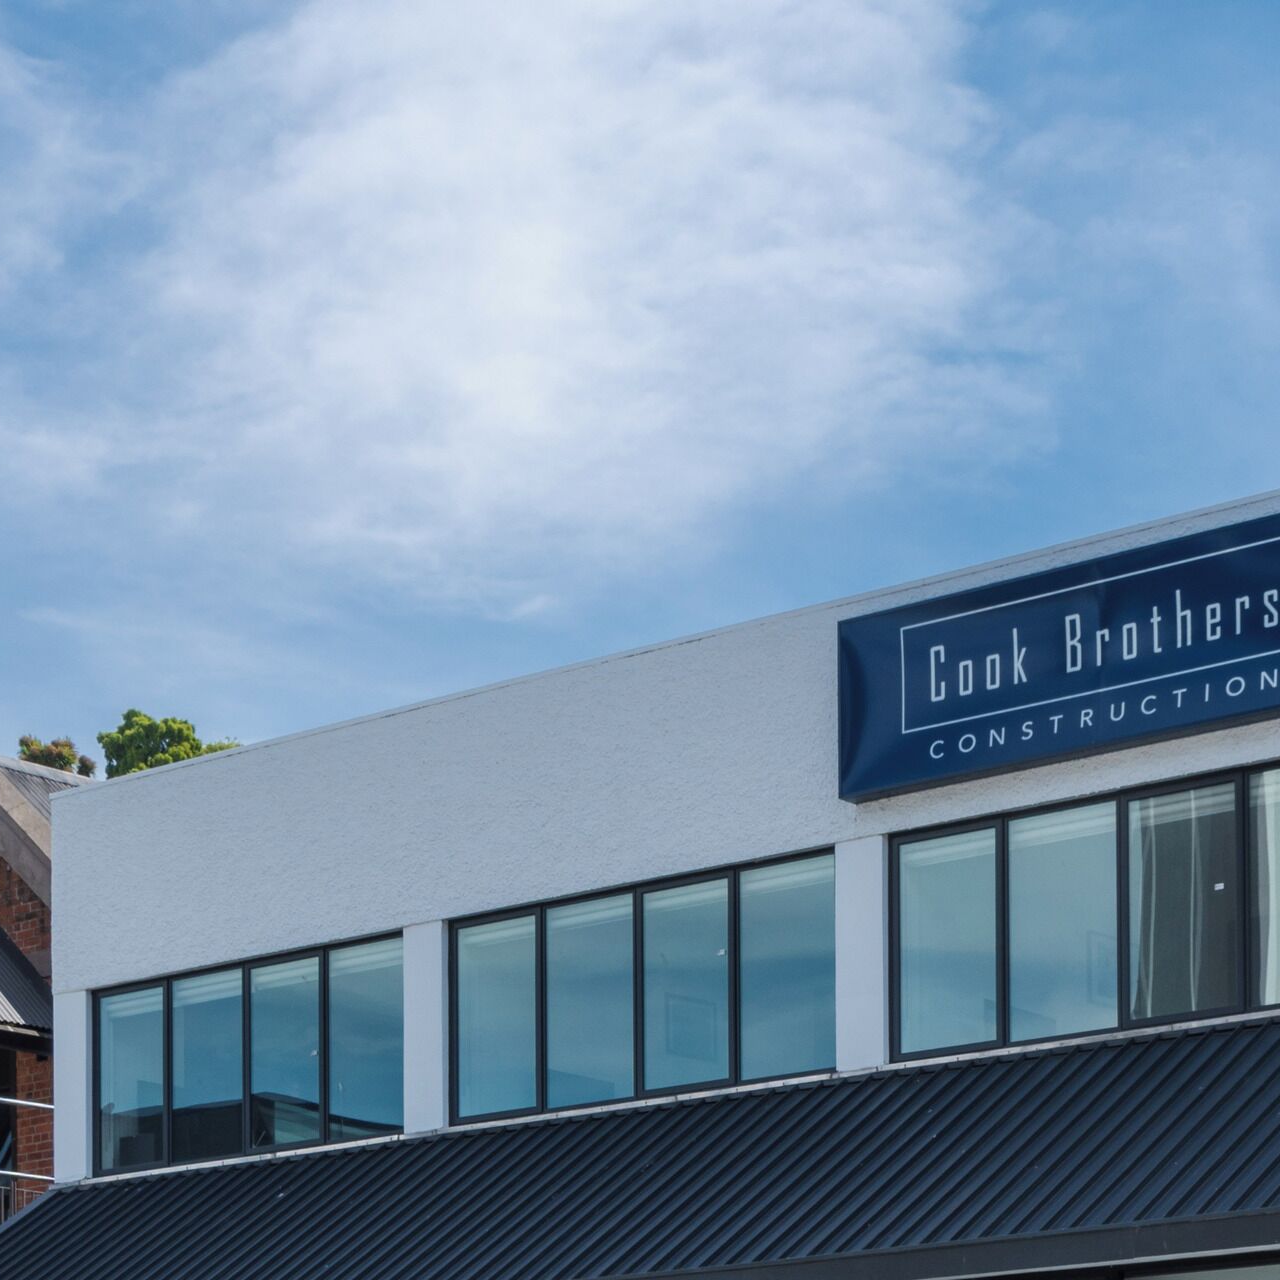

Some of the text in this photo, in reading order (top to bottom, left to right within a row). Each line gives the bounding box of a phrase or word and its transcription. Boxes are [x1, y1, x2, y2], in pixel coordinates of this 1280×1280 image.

[929, 588, 1279, 703] Cook Brothers
[928, 668, 1280, 760] CONSTRUCTION
